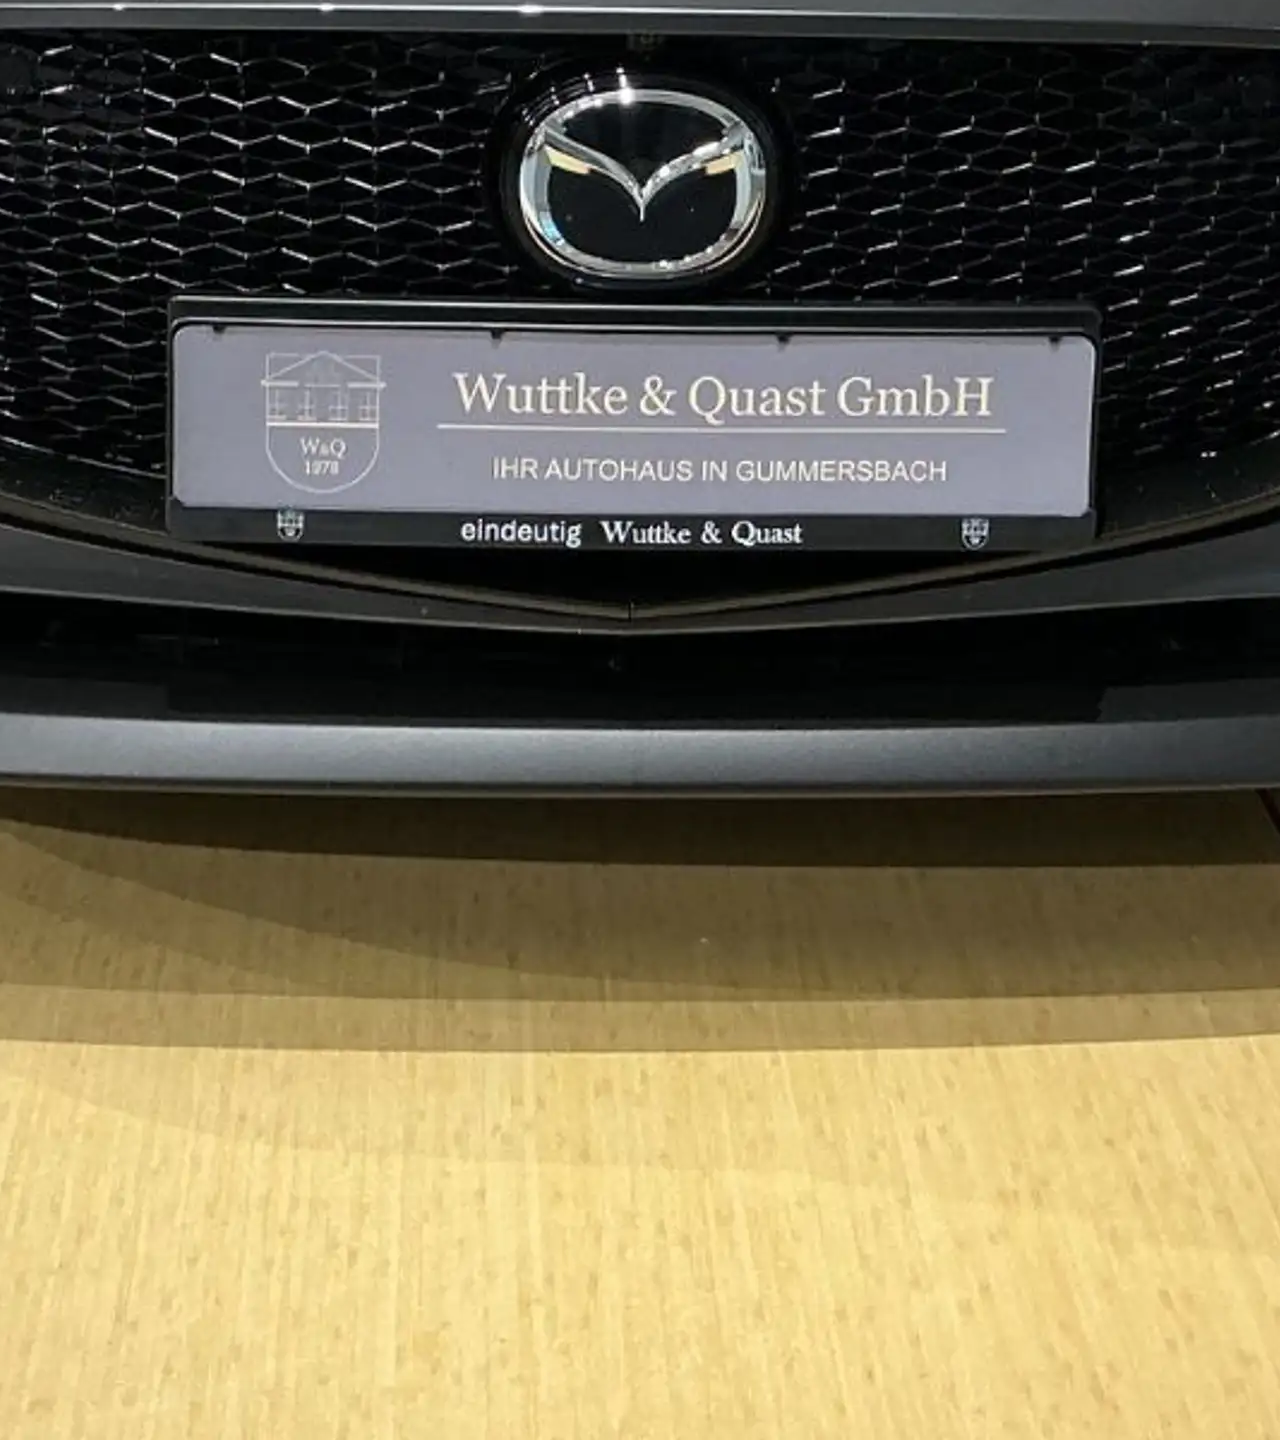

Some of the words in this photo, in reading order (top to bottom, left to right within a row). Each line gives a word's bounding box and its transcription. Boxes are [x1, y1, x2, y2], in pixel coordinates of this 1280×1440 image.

[453, 372, 628, 415] Wuttke
[639, 375, 677, 416] &
[689, 376, 827, 426] Quast
[837, 374, 993, 417] GmbH
[493, 457, 538, 480] IHR
[544, 458, 693, 482] AUTOHAUS
[702, 459, 728, 482] IN
[735, 459, 947, 483] GUMMERSBACH
[460, 518, 582, 549] eindeutig
[600, 520, 692, 544] Wuttke
[700, 520, 723, 544] &
[731, 520, 802, 547] Quast
